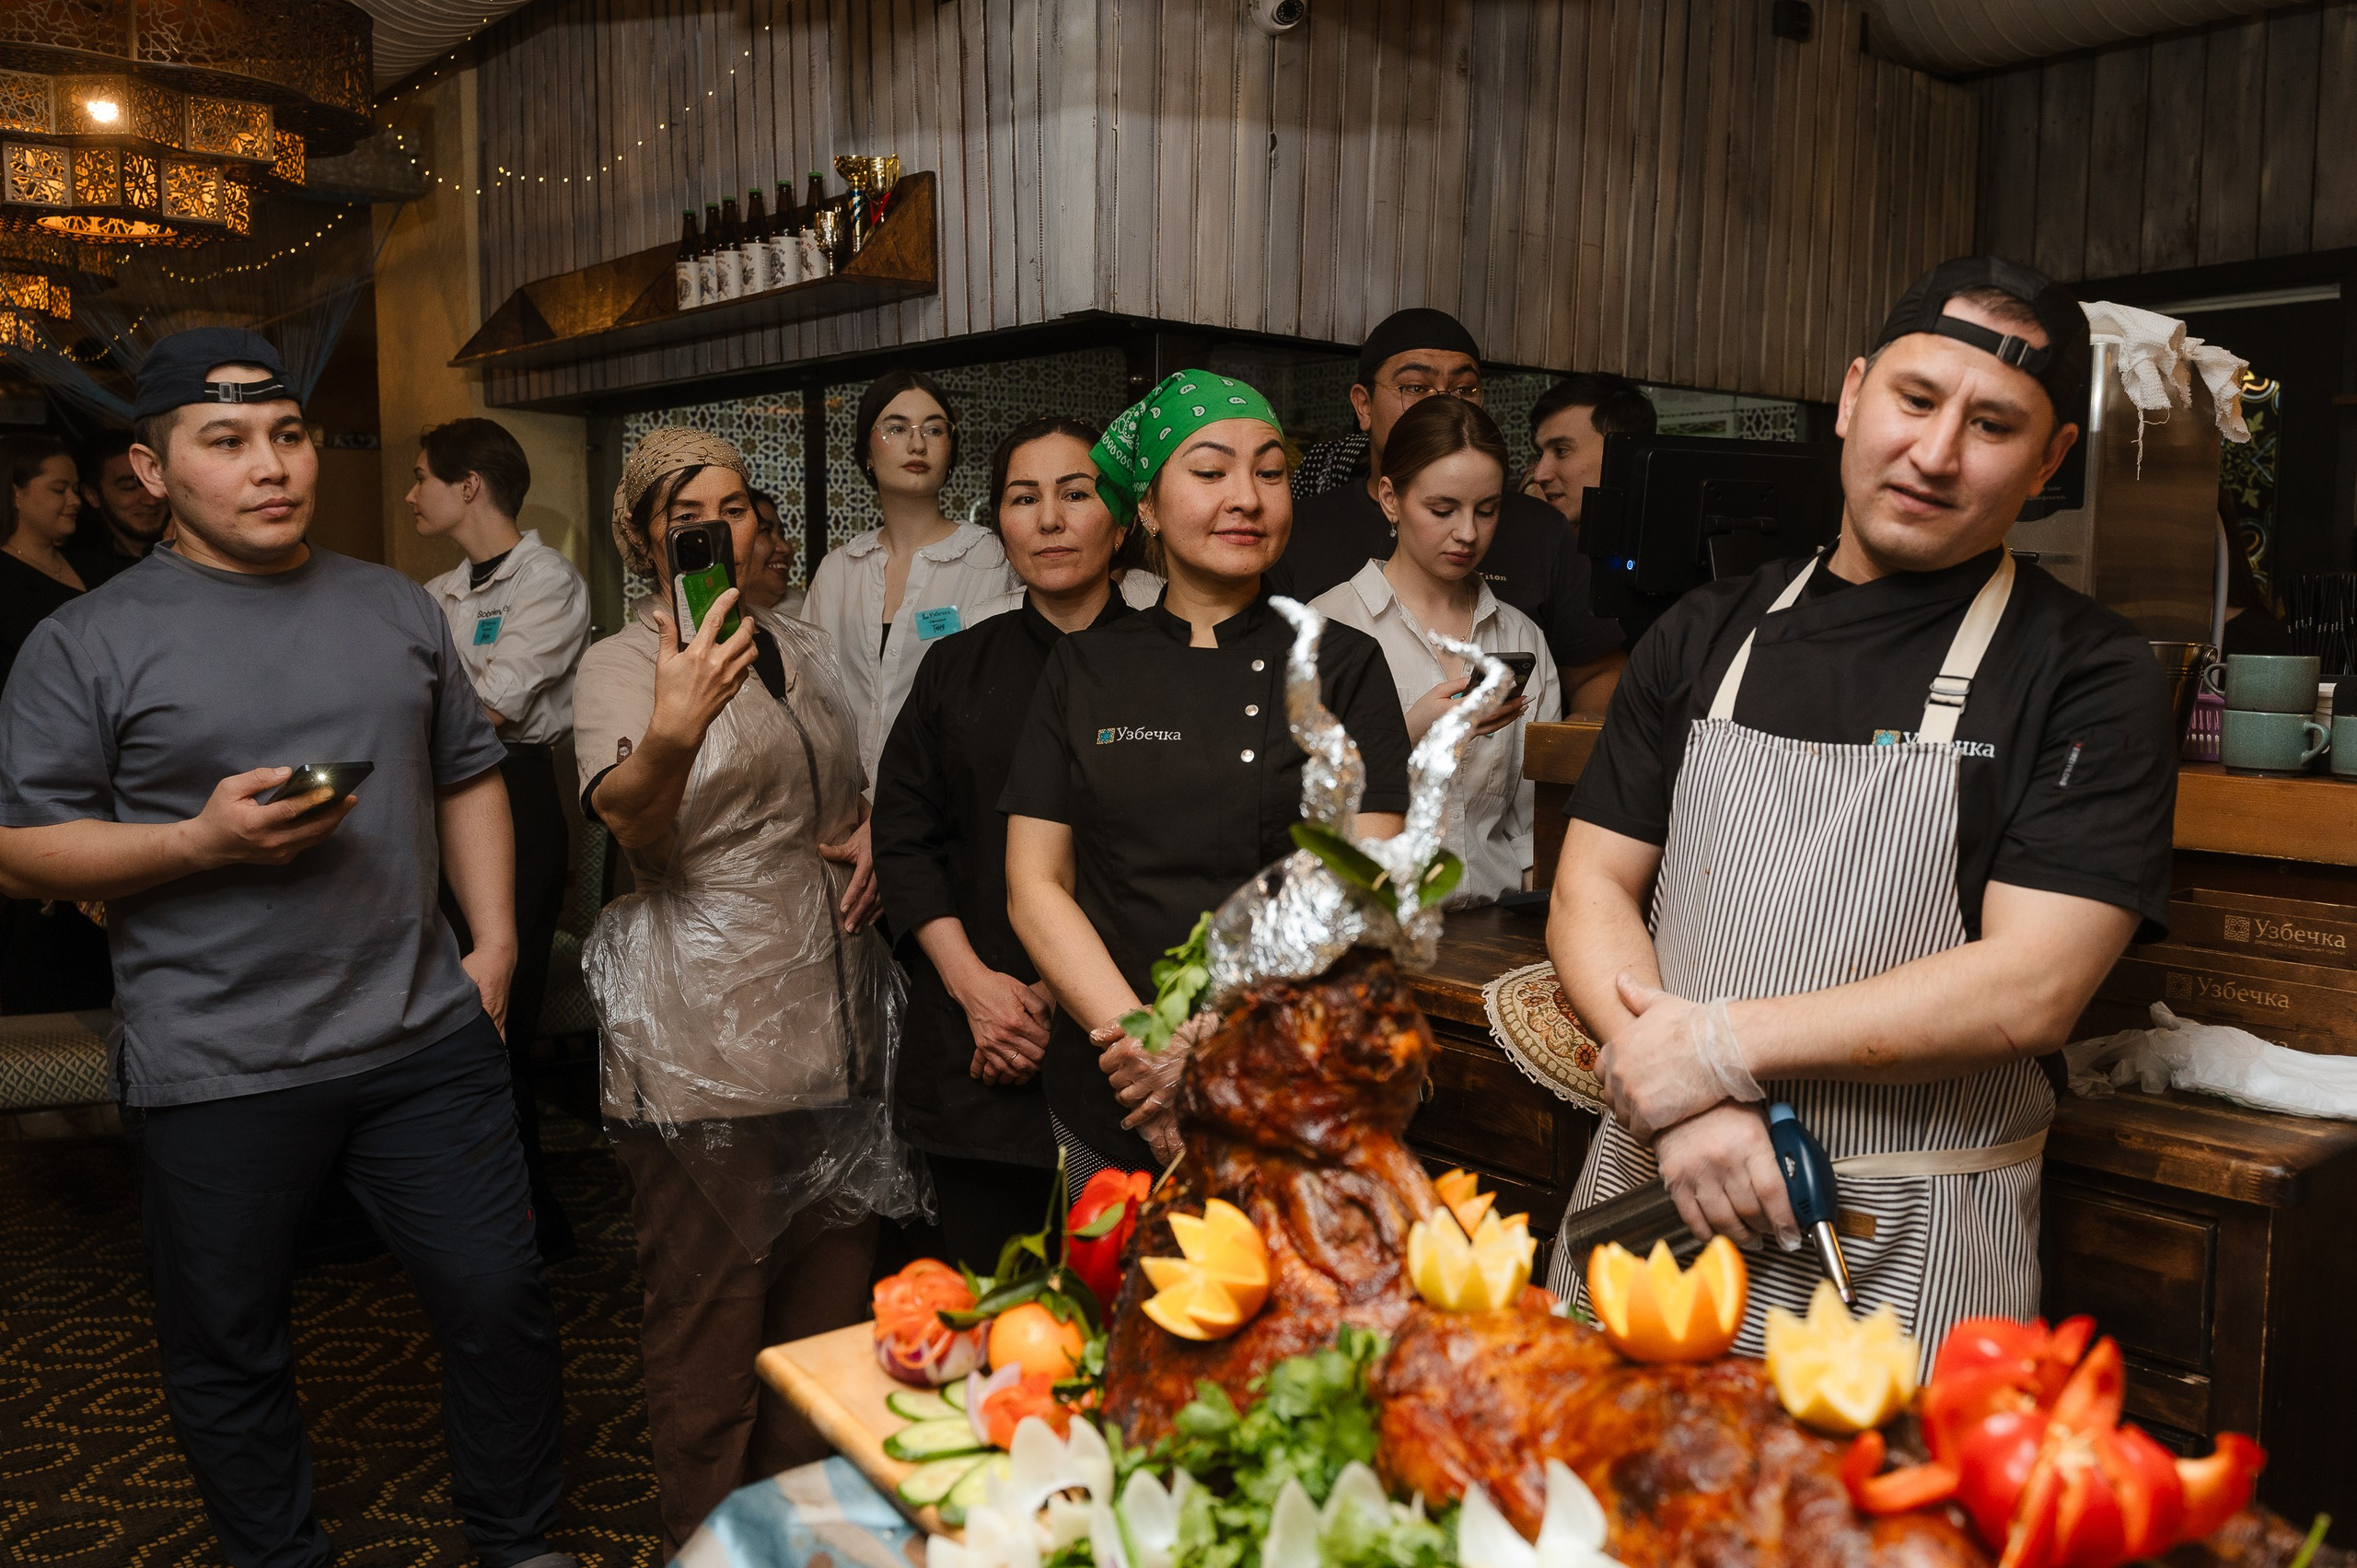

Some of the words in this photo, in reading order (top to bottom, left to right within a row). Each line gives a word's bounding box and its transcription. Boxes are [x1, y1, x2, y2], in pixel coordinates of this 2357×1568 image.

[1480, 572, 1507, 581] iton
[1116, 726, 1182, 741] Узбечка
[2254, 919, 2347, 948] Узбечка
[2197, 976, 2290, 1009] Узбечка
